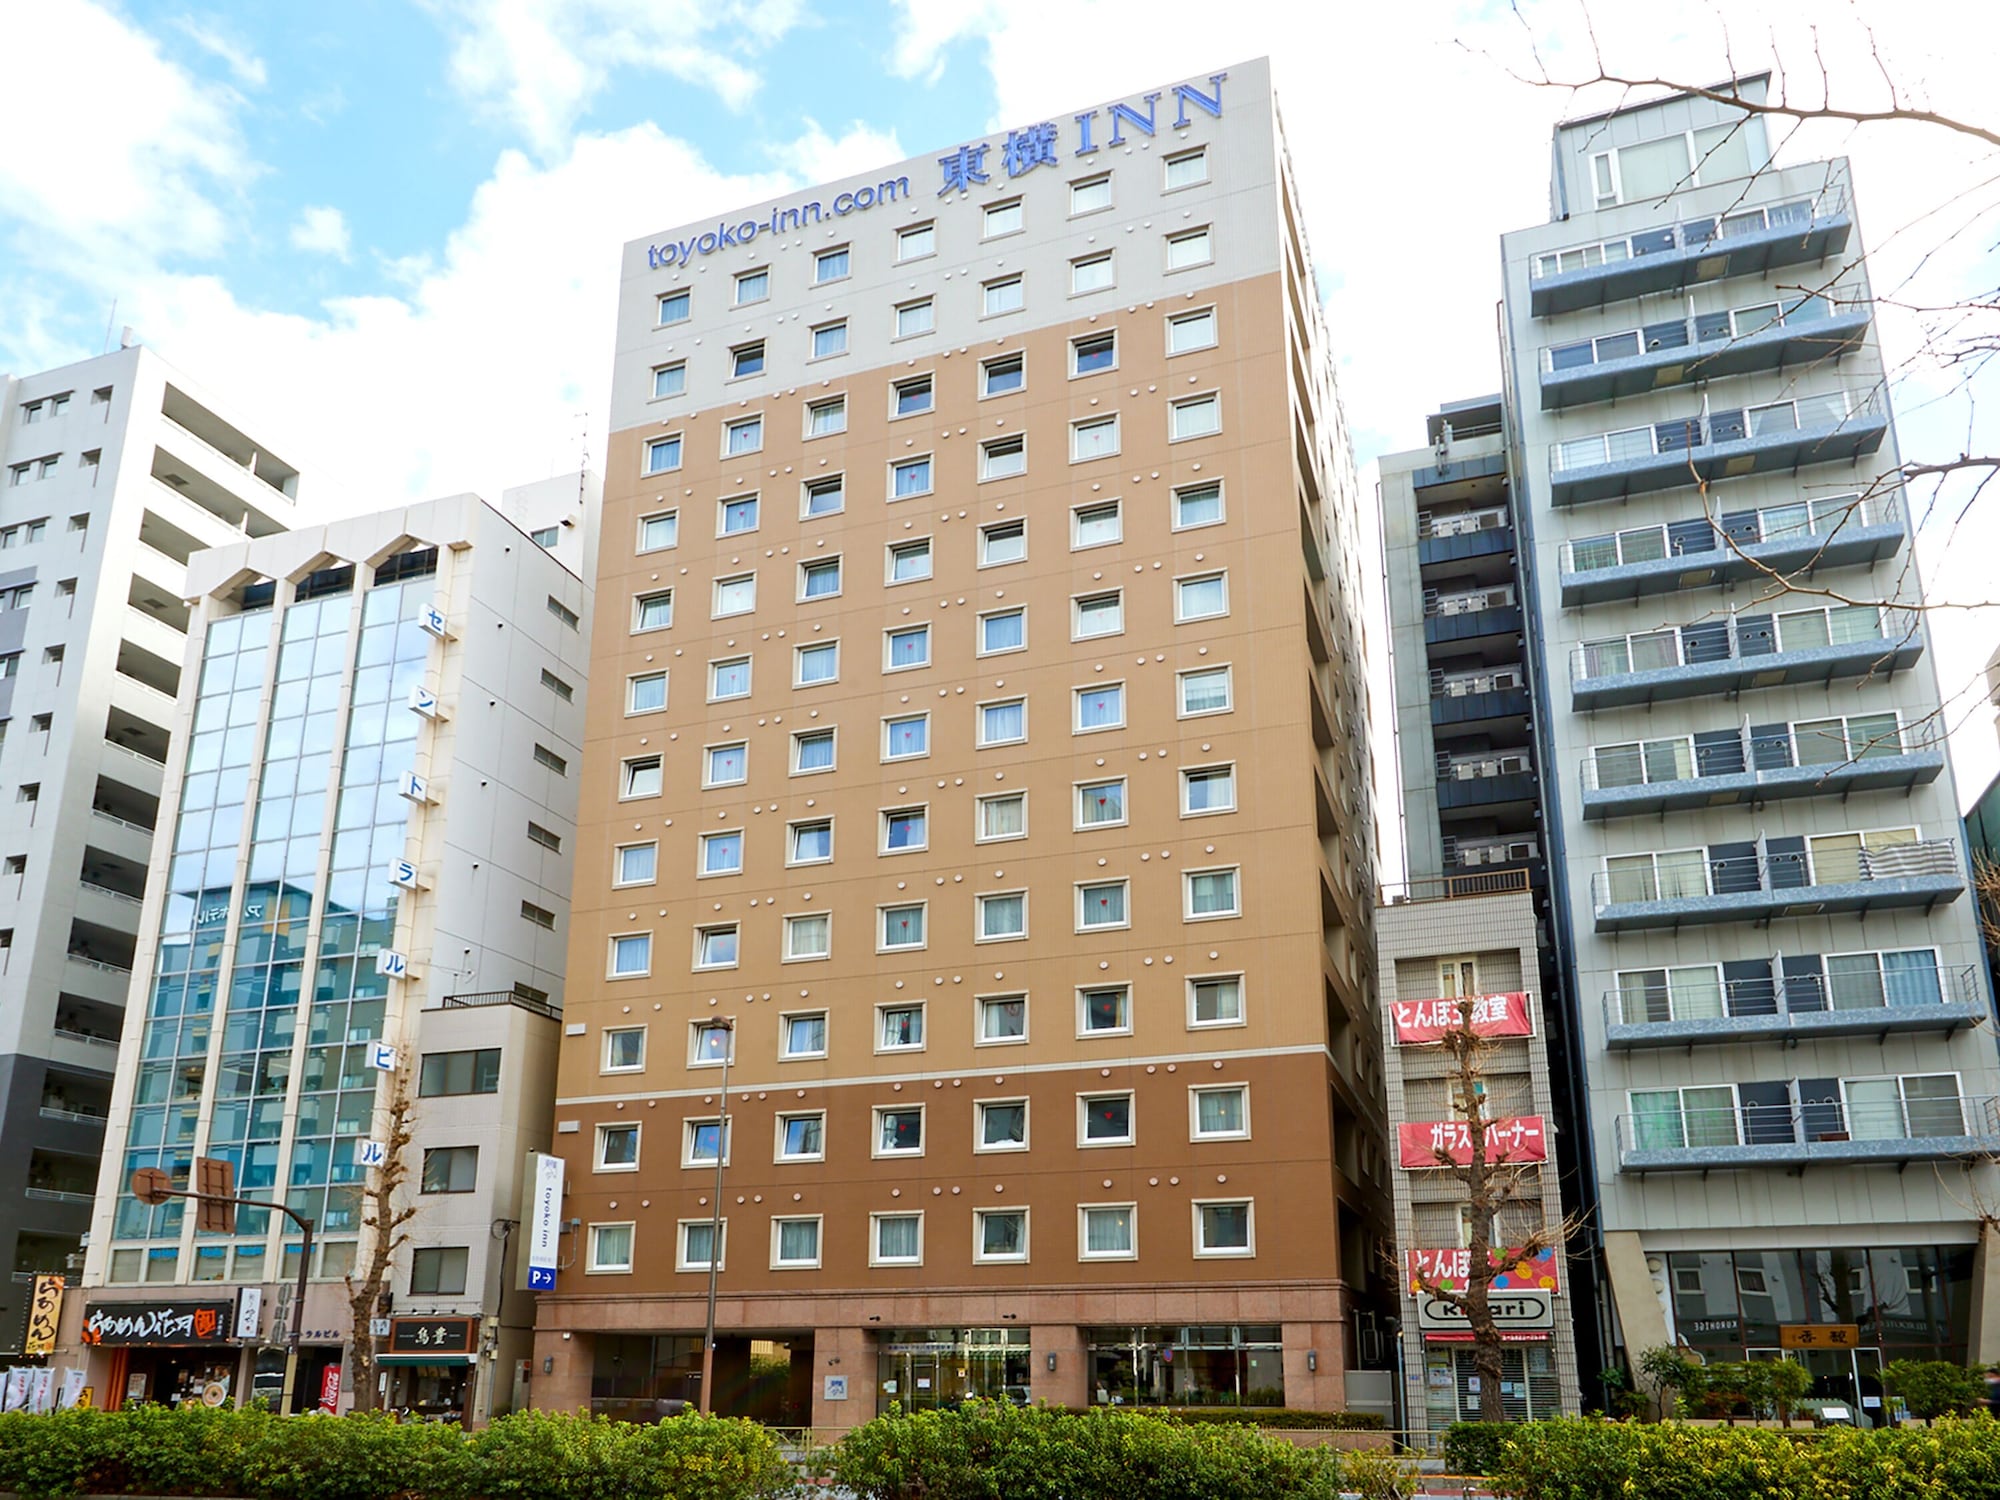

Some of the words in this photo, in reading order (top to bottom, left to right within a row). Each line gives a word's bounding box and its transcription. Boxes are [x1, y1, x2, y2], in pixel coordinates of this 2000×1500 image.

[648, 175, 910, 269] toyoko-inn.com
[543, 1187, 552, 1226] toyoko
[541, 1230, 550, 1247] inn
[532, 1270, 541, 1284] P
[1416, 1250, 1491, 1279] とんぼ
